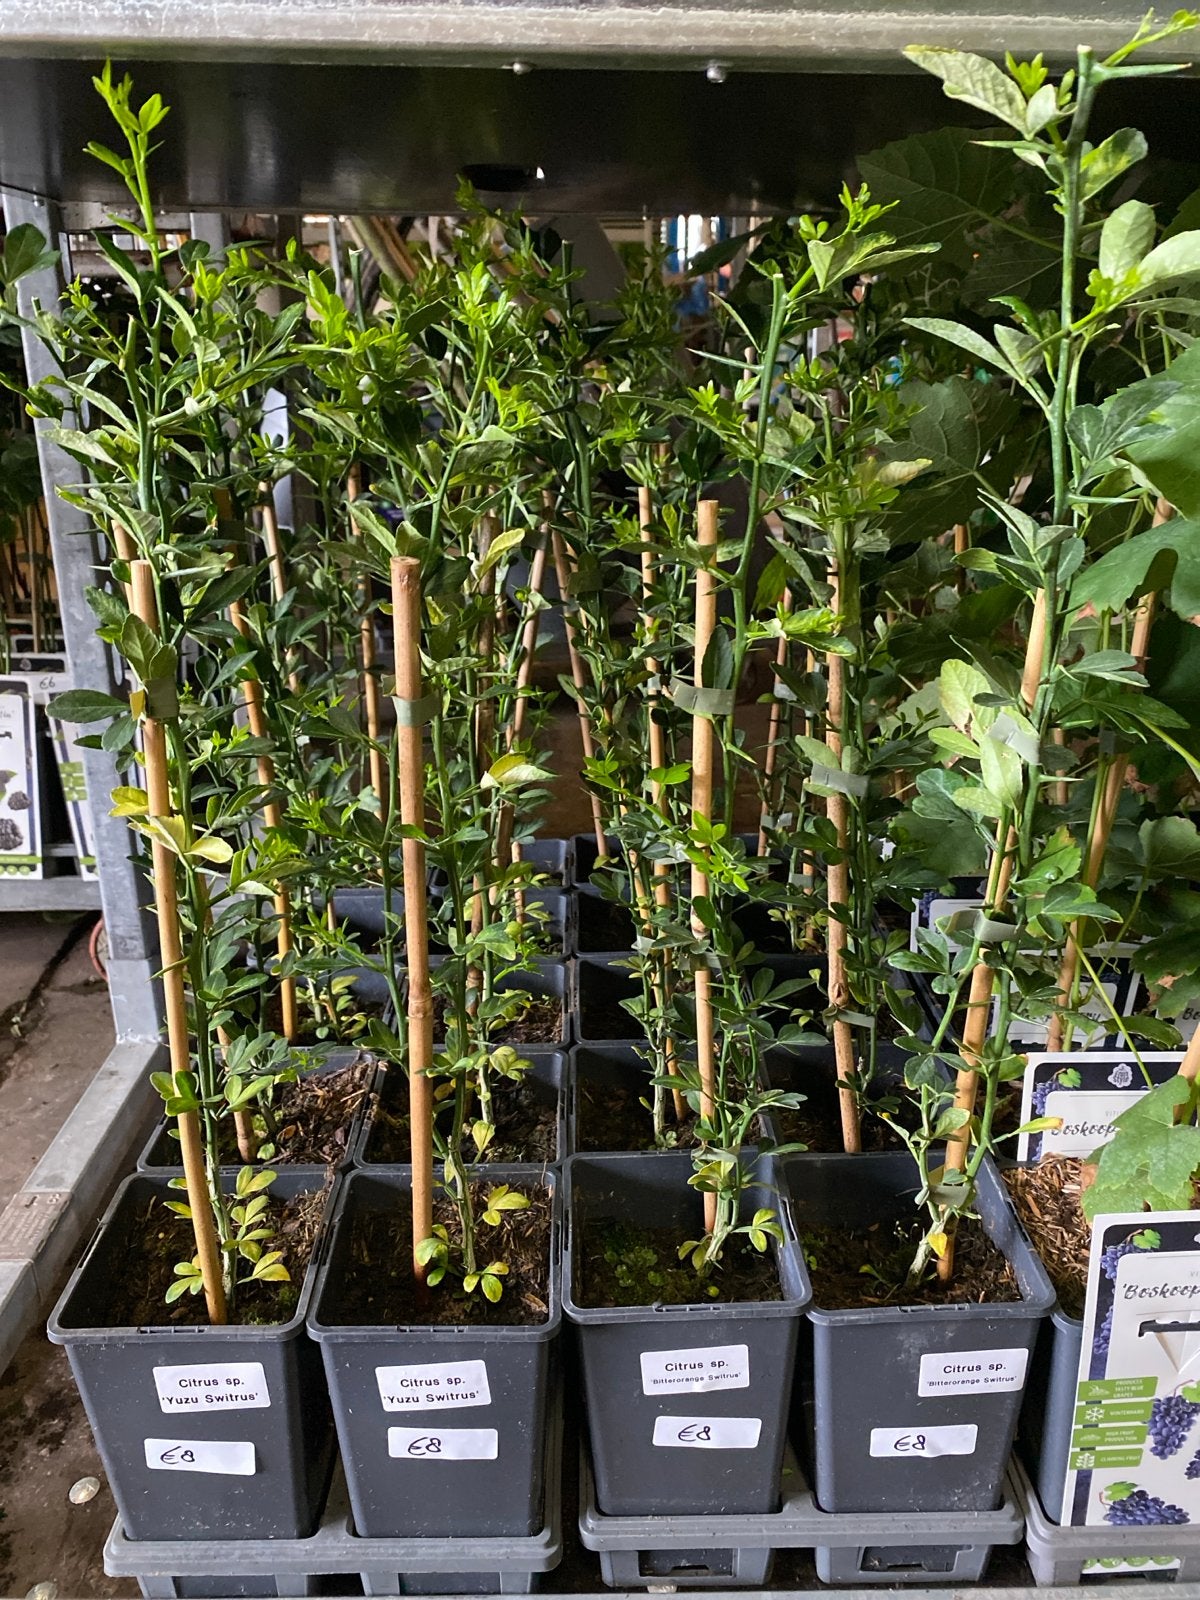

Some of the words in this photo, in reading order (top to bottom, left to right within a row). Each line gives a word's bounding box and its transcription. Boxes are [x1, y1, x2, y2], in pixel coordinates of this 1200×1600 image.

[664, 1361, 704, 1372] Citrus
[710, 1360, 729, 1369] sp.
[943, 1364, 982, 1374] Citrus
[988, 1362, 1007, 1371] sp.
[178, 1378, 219, 1388] Citrus
[225, 1377, 245, 1387] sp.
[400, 1378, 440, 1388] Citrus
[446, 1376, 466, 1386] sp.
[651, 1375, 705, 1385] 'Bitterorange
[708, 1371, 742, 1381] Switrus'
[926, 1377, 980, 1387] 'Bitterorange
[984, 1375, 1018, 1384] Switrus'
[162, 1396, 199, 1405] 'Yuzu
[205, 1392, 259, 1404] Switrus'
[383, 1395, 420, 1404] 'Yuzu
[426, 1390, 480, 1403] Switrus'
[678, 1423, 712, 1443] €8
[407, 1436, 442, 1456] €8
[894, 1434, 927, 1452] €8
[160, 1445, 196, 1465] €8
